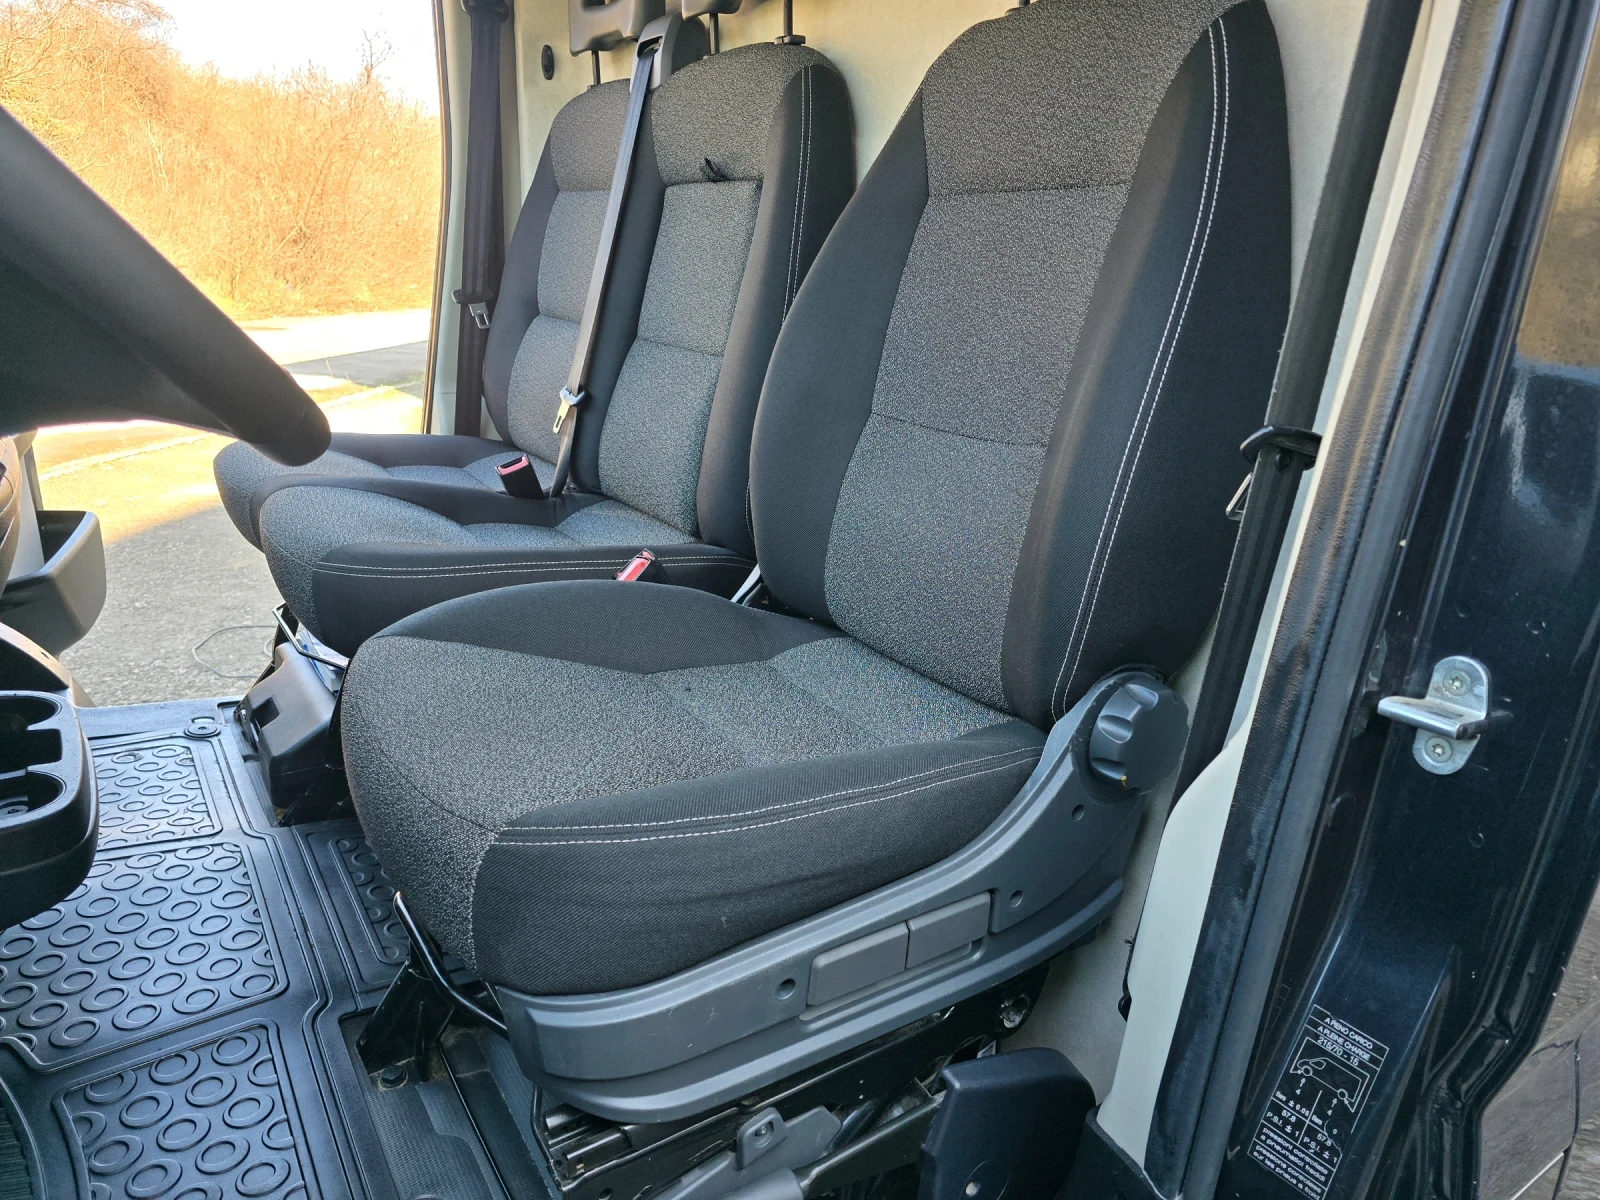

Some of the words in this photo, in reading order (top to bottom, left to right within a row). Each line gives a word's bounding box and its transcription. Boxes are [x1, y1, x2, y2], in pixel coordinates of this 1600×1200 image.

[1323, 1029, 1344, 1045] PLEINE
[1344, 1042, 1371, 1060] CHARGE
[1331, 1020, 1349, 1035] PIENO
[1349, 1030, 1372, 1049] CARICO
[1318, 1037, 1343, 1056] 215/70
[1350, 1057, 1358, 1066] 15
[1263, 1128, 1293, 1150] pressioni
[1267, 1139, 1304, 1167] pneumatici
[1305, 1165, 1325, 1182] freddi
[1253, 1152, 1264, 1160] sur
[1265, 1159, 1274, 1168] les
[1276, 1168, 1296, 1184] pneus
[1304, 1187, 1320, 1200] froid
